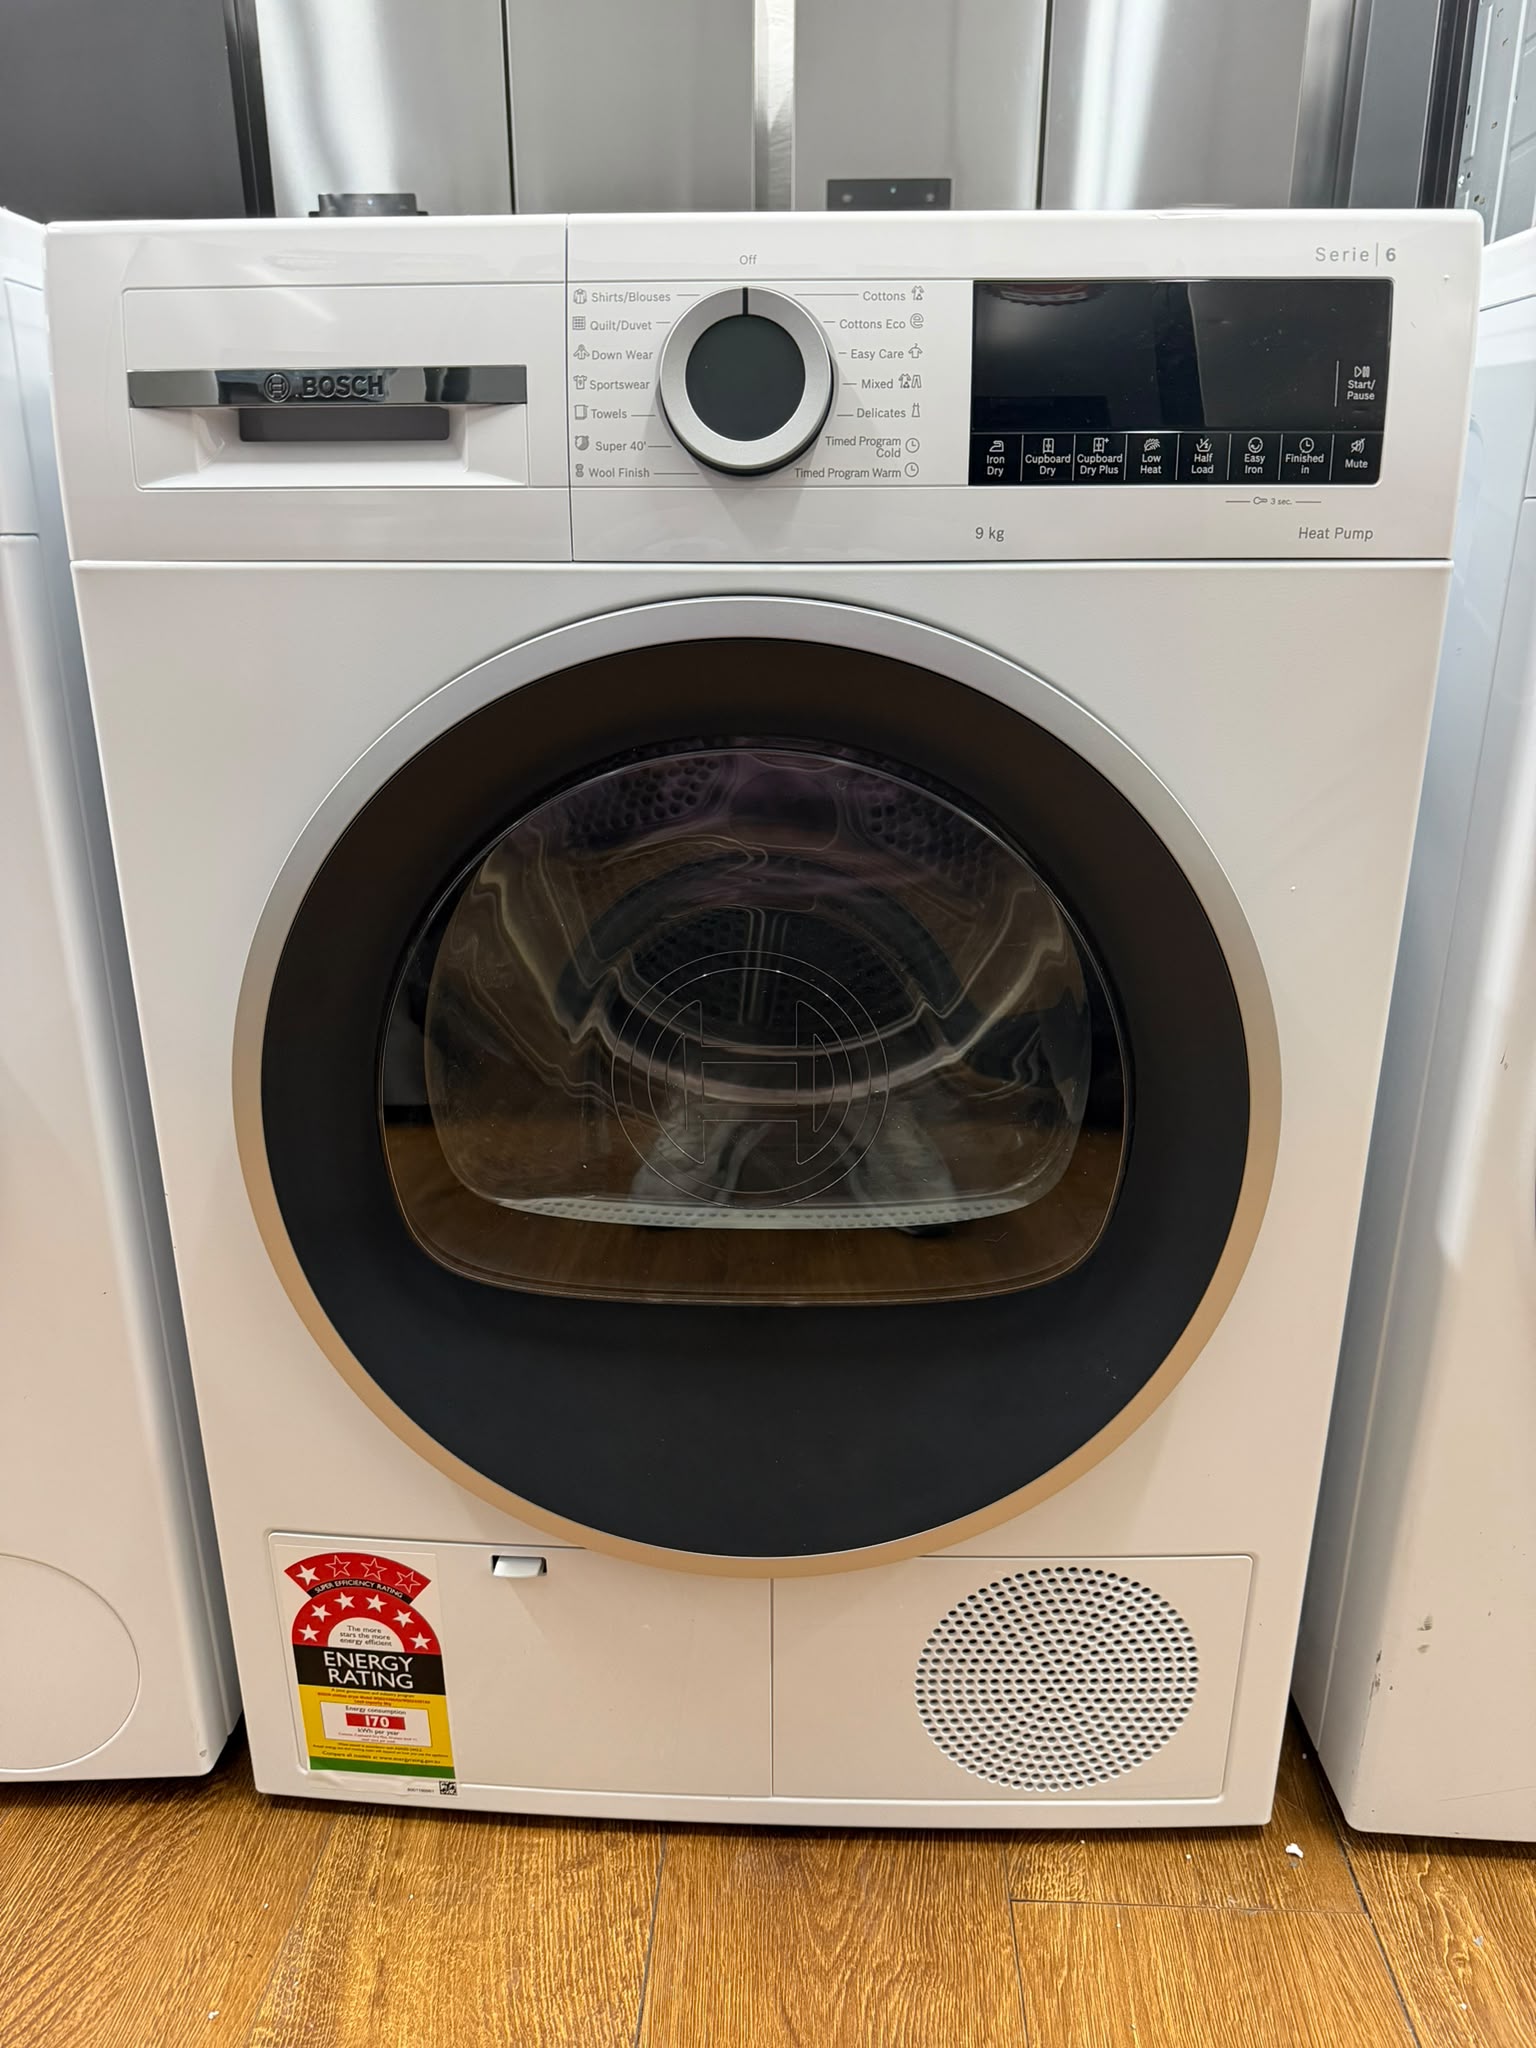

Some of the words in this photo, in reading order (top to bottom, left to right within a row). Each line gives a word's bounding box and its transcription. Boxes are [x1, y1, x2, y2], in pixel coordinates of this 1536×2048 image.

[739, 254, 757, 265] Off
[1315, 246, 1370, 262] Serie
[1386, 247, 1397, 262] 6
[591, 291, 671, 303] Shirts/Blouses
[862, 291, 906, 302] Cottons
[590, 320, 652, 332] Quilt/Duvet
[839, 318, 883, 329] Cottons
[885, 318, 906, 329] Eco
[591, 350, 622, 360] Down
[626, 350, 653, 360] Wear
[851, 348, 876, 361] Easy
[878, 348, 904, 359] Care
[301, 374, 385, 398] BOSCH
[589, 379, 650, 391] Sportswear
[861, 378, 894, 389] Mixed
[1347, 379, 1376, 391] Start/
[1347, 390, 1375, 401] Pause
[591, 408, 627, 419] Towels
[856, 407, 906, 418] Delicates
[595, 441, 627, 453] Super
[825, 435, 856, 446] Timed
[858, 436, 901, 448] Program
[876, 447, 901, 458] Cold
[1193, 453, 1213, 463] Half
[1285, 453, 1324, 463] Finished
[986, 454, 1005, 464] Iron
[1025, 454, 1071, 465] Cupboard
[1077, 453, 1123, 465] Cupboard
[1141, 454, 1161, 463] Low
[1244, 454, 1266, 465] Easy
[1345, 459, 1369, 469] Mute
[589, 468, 615, 478] Wool
[618, 468, 650, 478] Finish
[794, 467, 825, 478] Timed
[827, 468, 870, 480] Program
[872, 467, 901, 478] Warm
[987, 465, 1004, 477] Dry
[1039, 465, 1056, 477] Dry
[1079, 465, 1097, 476] Dry
[1099, 465, 1119, 474] Plus
[1140, 465, 1162, 474] Heat
[1191, 465, 1214, 474] Load
[1244, 465, 1263, 474] Iron
[1301, 465, 1309, 474] in
[975, 527, 984, 540] 9
[988, 527, 1005, 542] kg
[1298, 527, 1330, 539] Heat
[1334, 527, 1374, 541] Pump
[314, 1583, 334, 1593] SUPER
[334, 1580, 375, 1589] EFFICIENCY
[376, 1583, 404, 1598] RATING
[323, 1650, 414, 1672] ENERGY
[328, 1669, 414, 1690] RATING
[345, 1705, 366, 1713] Energy
[367, 1707, 406, 1715] consumption
[365, 1715, 390, 1728] 170
